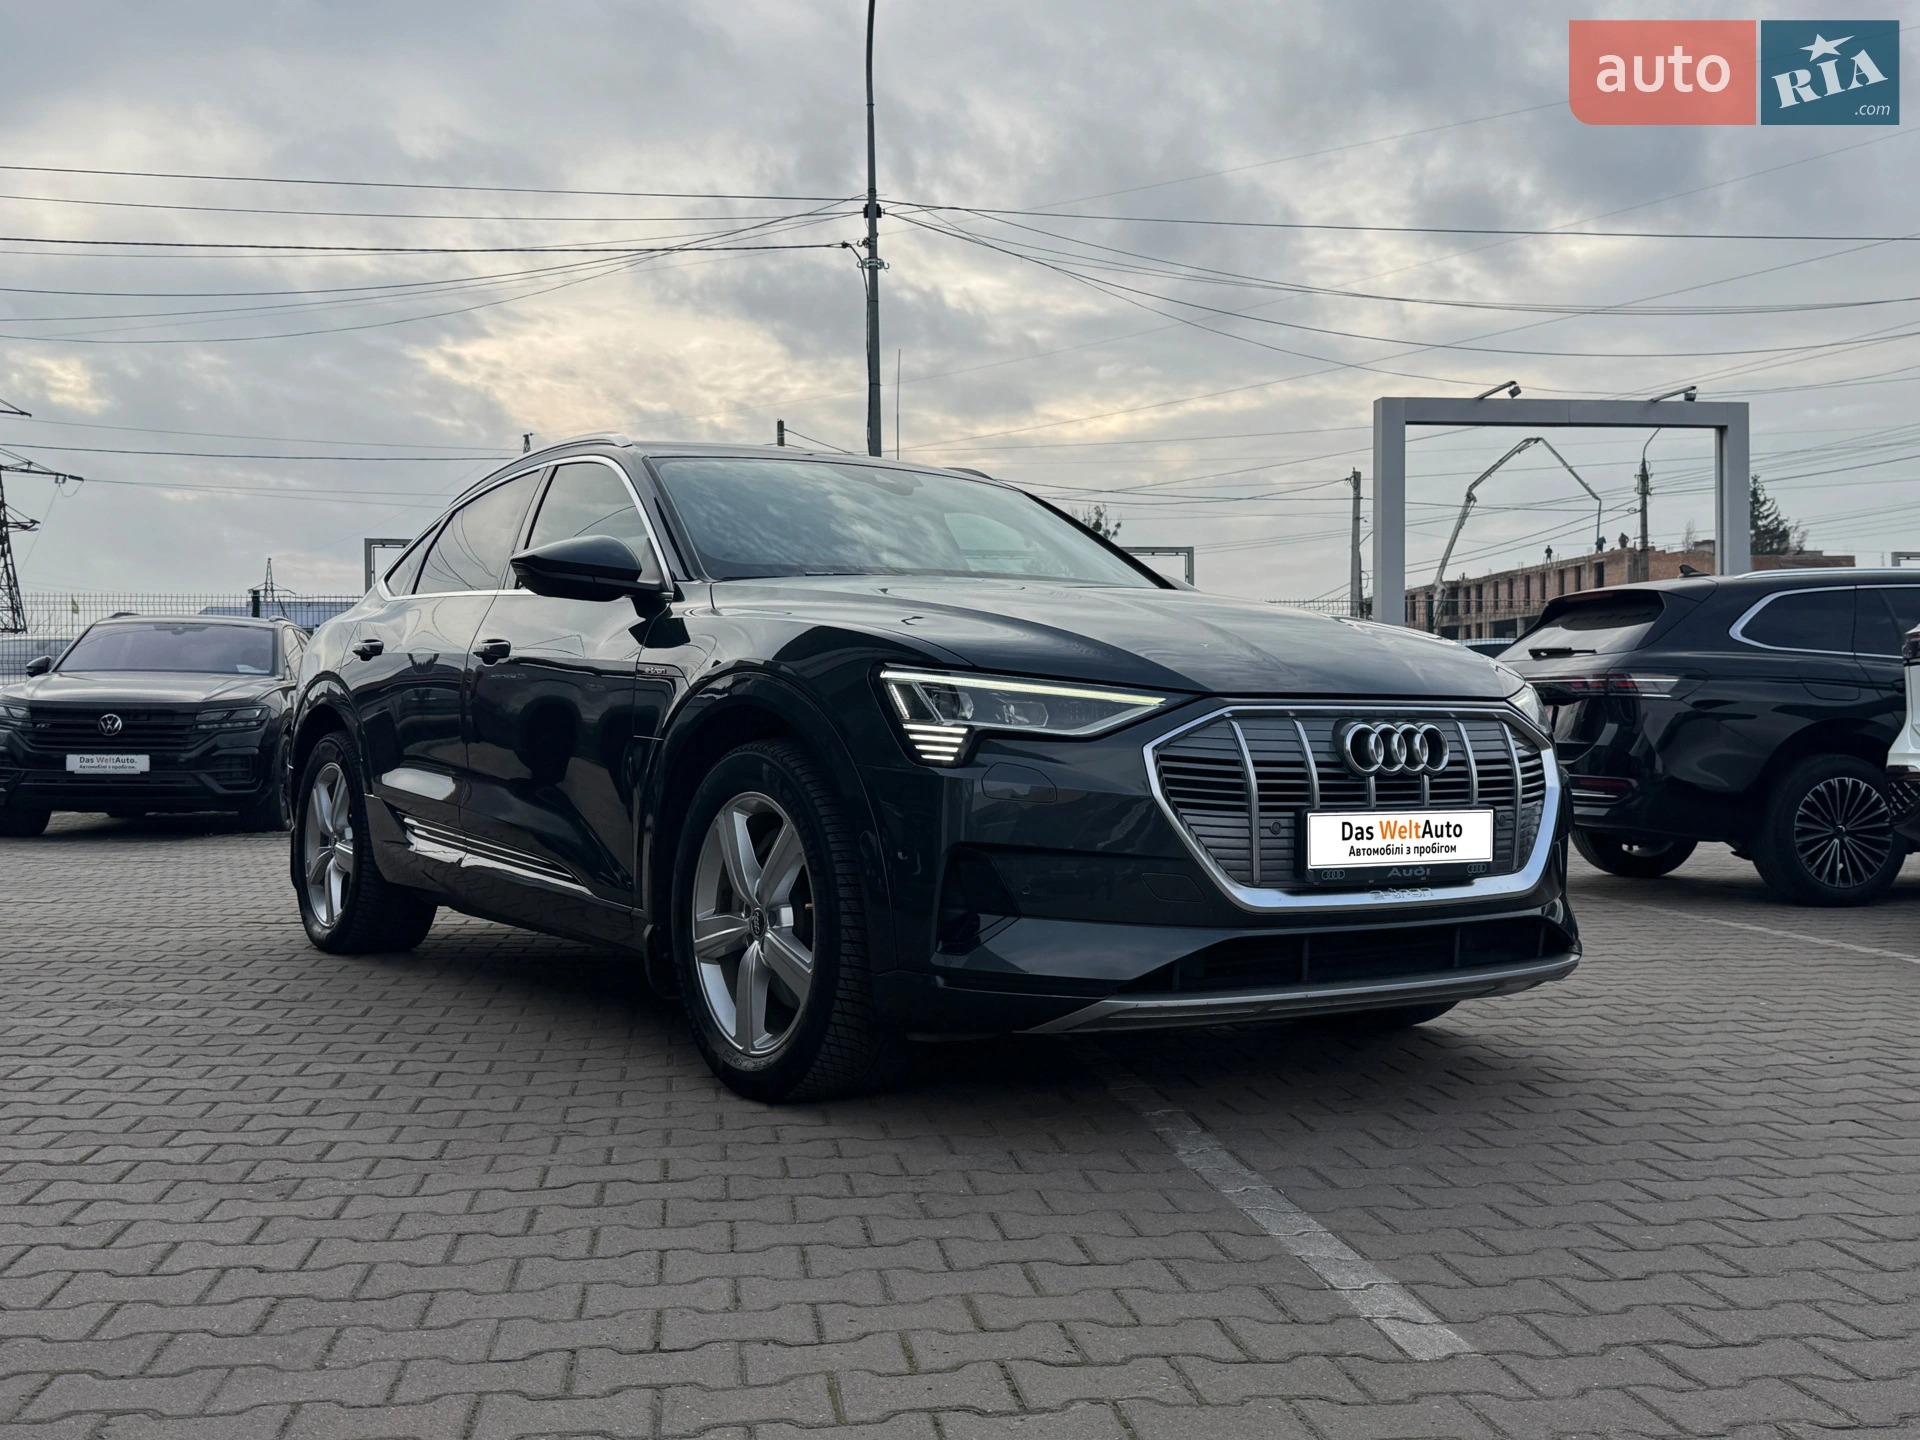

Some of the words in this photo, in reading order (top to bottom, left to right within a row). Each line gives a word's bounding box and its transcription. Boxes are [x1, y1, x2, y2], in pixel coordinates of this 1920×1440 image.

[1342, 822, 1374, 840] Das
[1379, 820, 1462, 839] WeltAuto
[1349, 844, 1403, 856] Автомобілі
[1413, 842, 1456, 857] пробігом
[1387, 866, 1431, 877] Audi
[1370, 888, 1433, 900] e-tron
